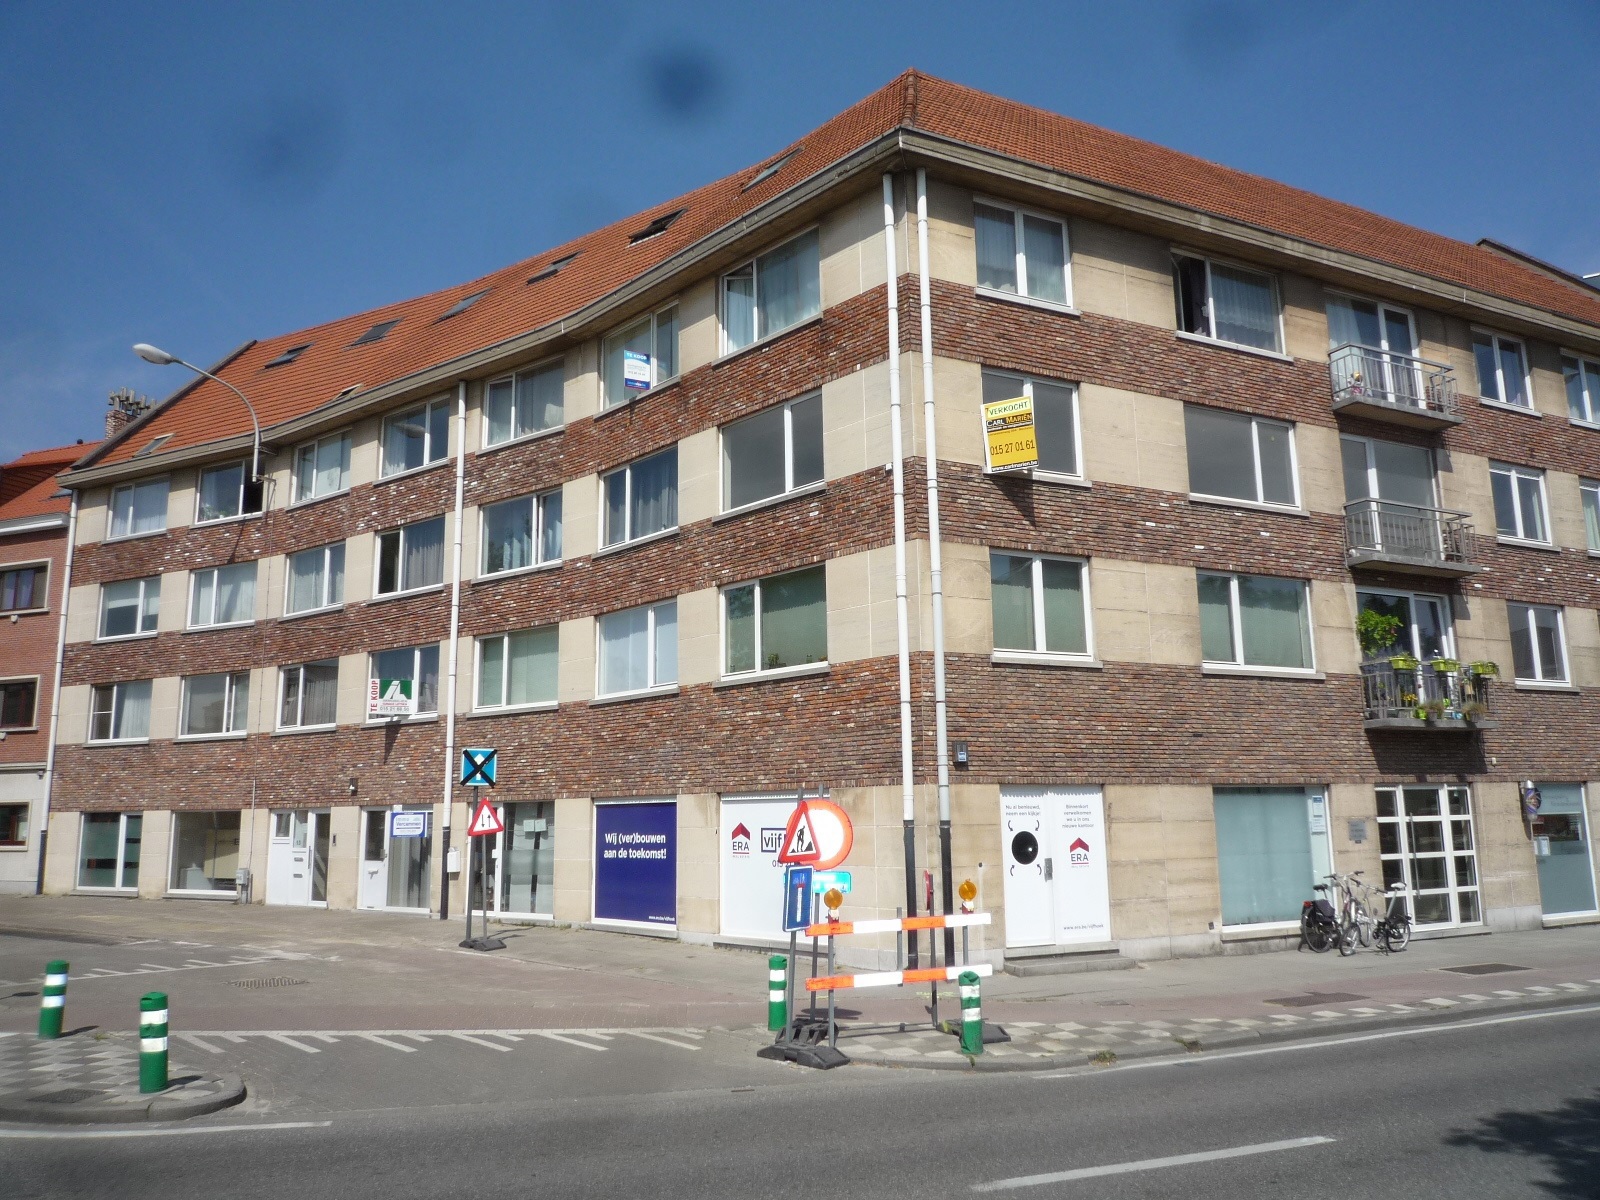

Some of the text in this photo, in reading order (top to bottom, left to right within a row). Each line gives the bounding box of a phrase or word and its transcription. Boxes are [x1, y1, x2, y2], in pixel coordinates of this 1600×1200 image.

[989, 401, 1028, 416] VERKOCHT
[986, 418, 1005, 427] CARL
[990, 440, 1035, 456] 015 27 01 61
[370, 680, 378, 712] TE KOOP
[605, 832, 666, 845] Wij (ver)bouwen
[763, 833, 786, 848] vijf
[732, 841, 750, 851] ERA
[604, 847, 667, 859] aan de toekomst!
[1070, 853, 1089, 862] ERA
